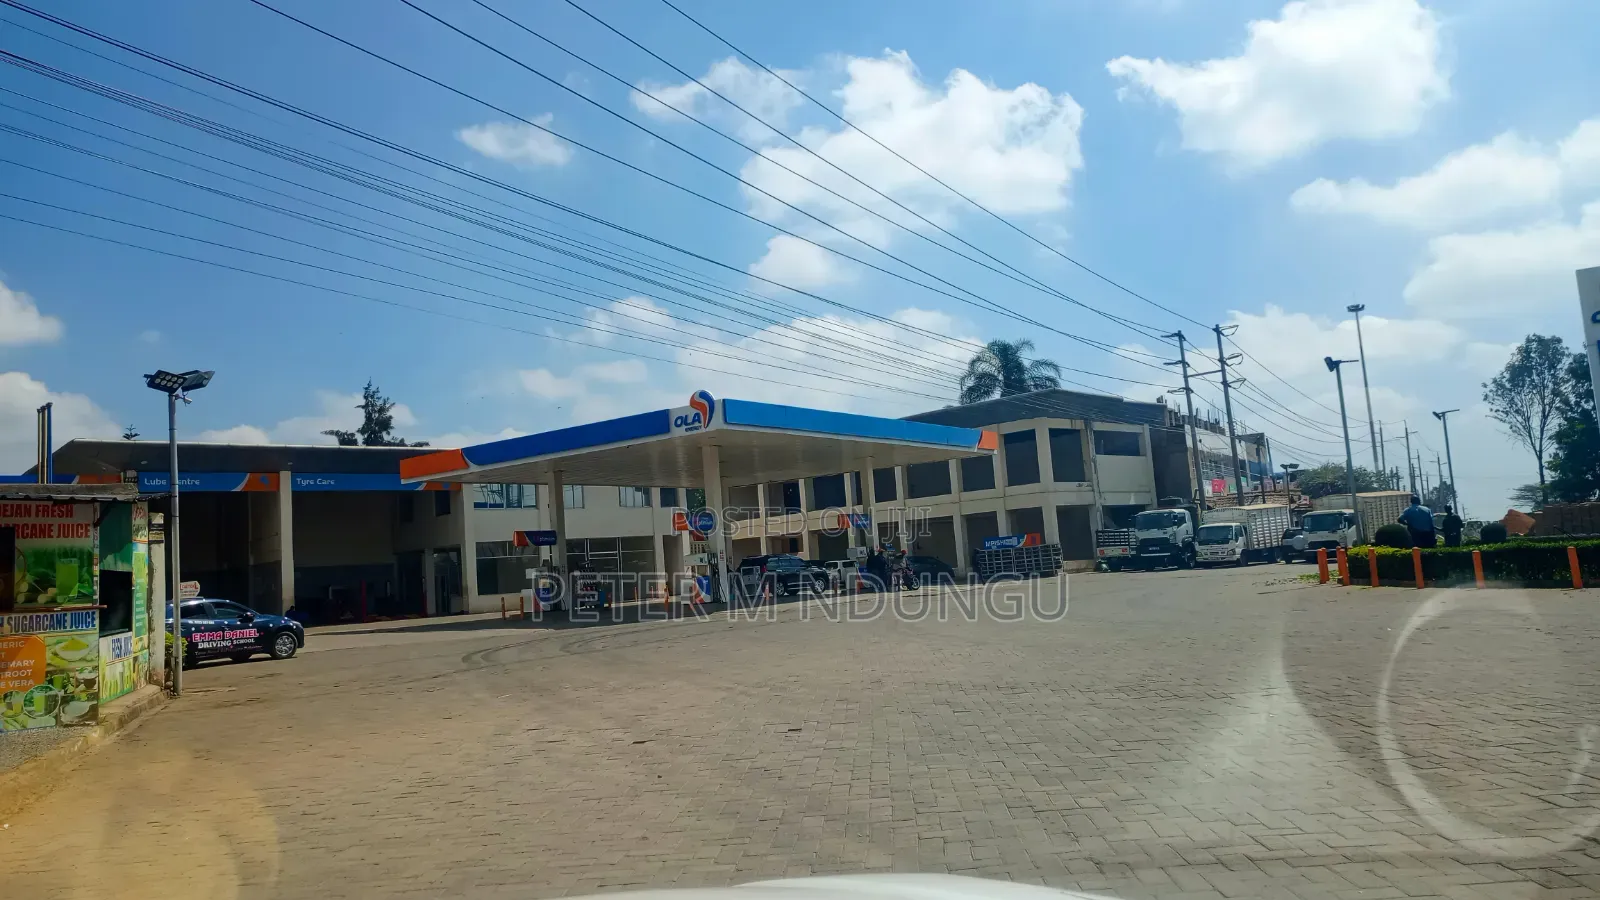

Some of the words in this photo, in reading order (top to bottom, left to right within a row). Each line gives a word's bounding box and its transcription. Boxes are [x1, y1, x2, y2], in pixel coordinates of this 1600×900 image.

[674, 412, 702, 428] OLA
[144, 478, 167, 486] Lube
[177, 478, 200, 486] entre
[296, 478, 315, 487] Tyre
[316, 478, 335, 486] Care
[0, 503, 32, 518] EJAN
[34, 504, 74, 518] FRESH
[0, 523, 54, 539] RCANE
[56, 523, 91, 539] JUICE
[7, 613, 68, 633] SUGARCANE
[70, 611, 96, 629] JUICE
[192, 631, 223, 642] EMMA
[224, 628, 259, 639] DANIEL
[198, 641, 232, 649] DRIVING
[8, 679, 35, 688] VERA
